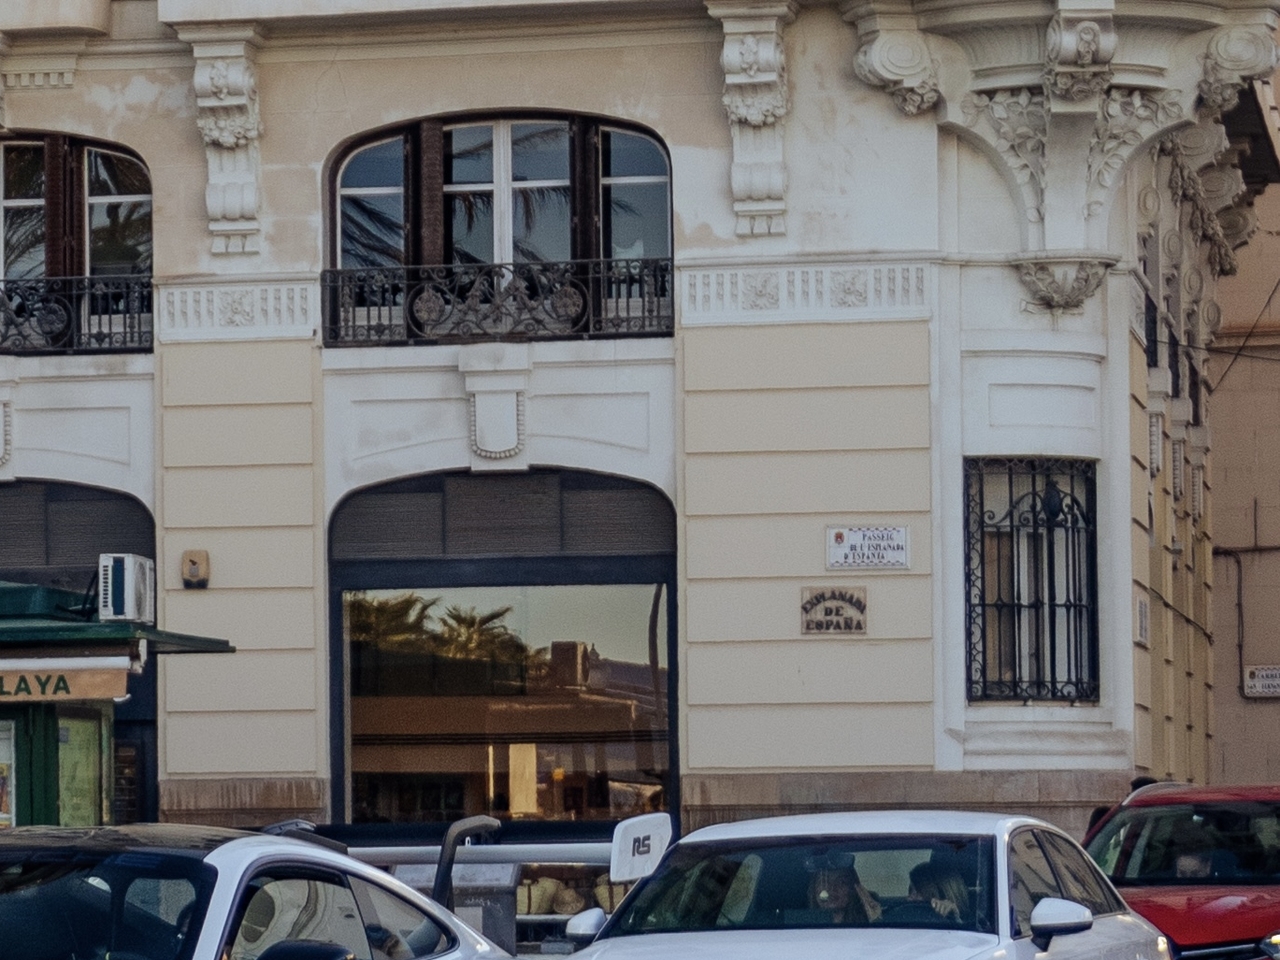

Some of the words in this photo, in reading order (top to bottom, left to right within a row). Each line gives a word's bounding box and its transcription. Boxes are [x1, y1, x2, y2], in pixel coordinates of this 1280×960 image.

[824, 606, 844, 616] DE
[806, 616, 863, 631] ESPAÑA
[632, 834, 651, 857] RS
